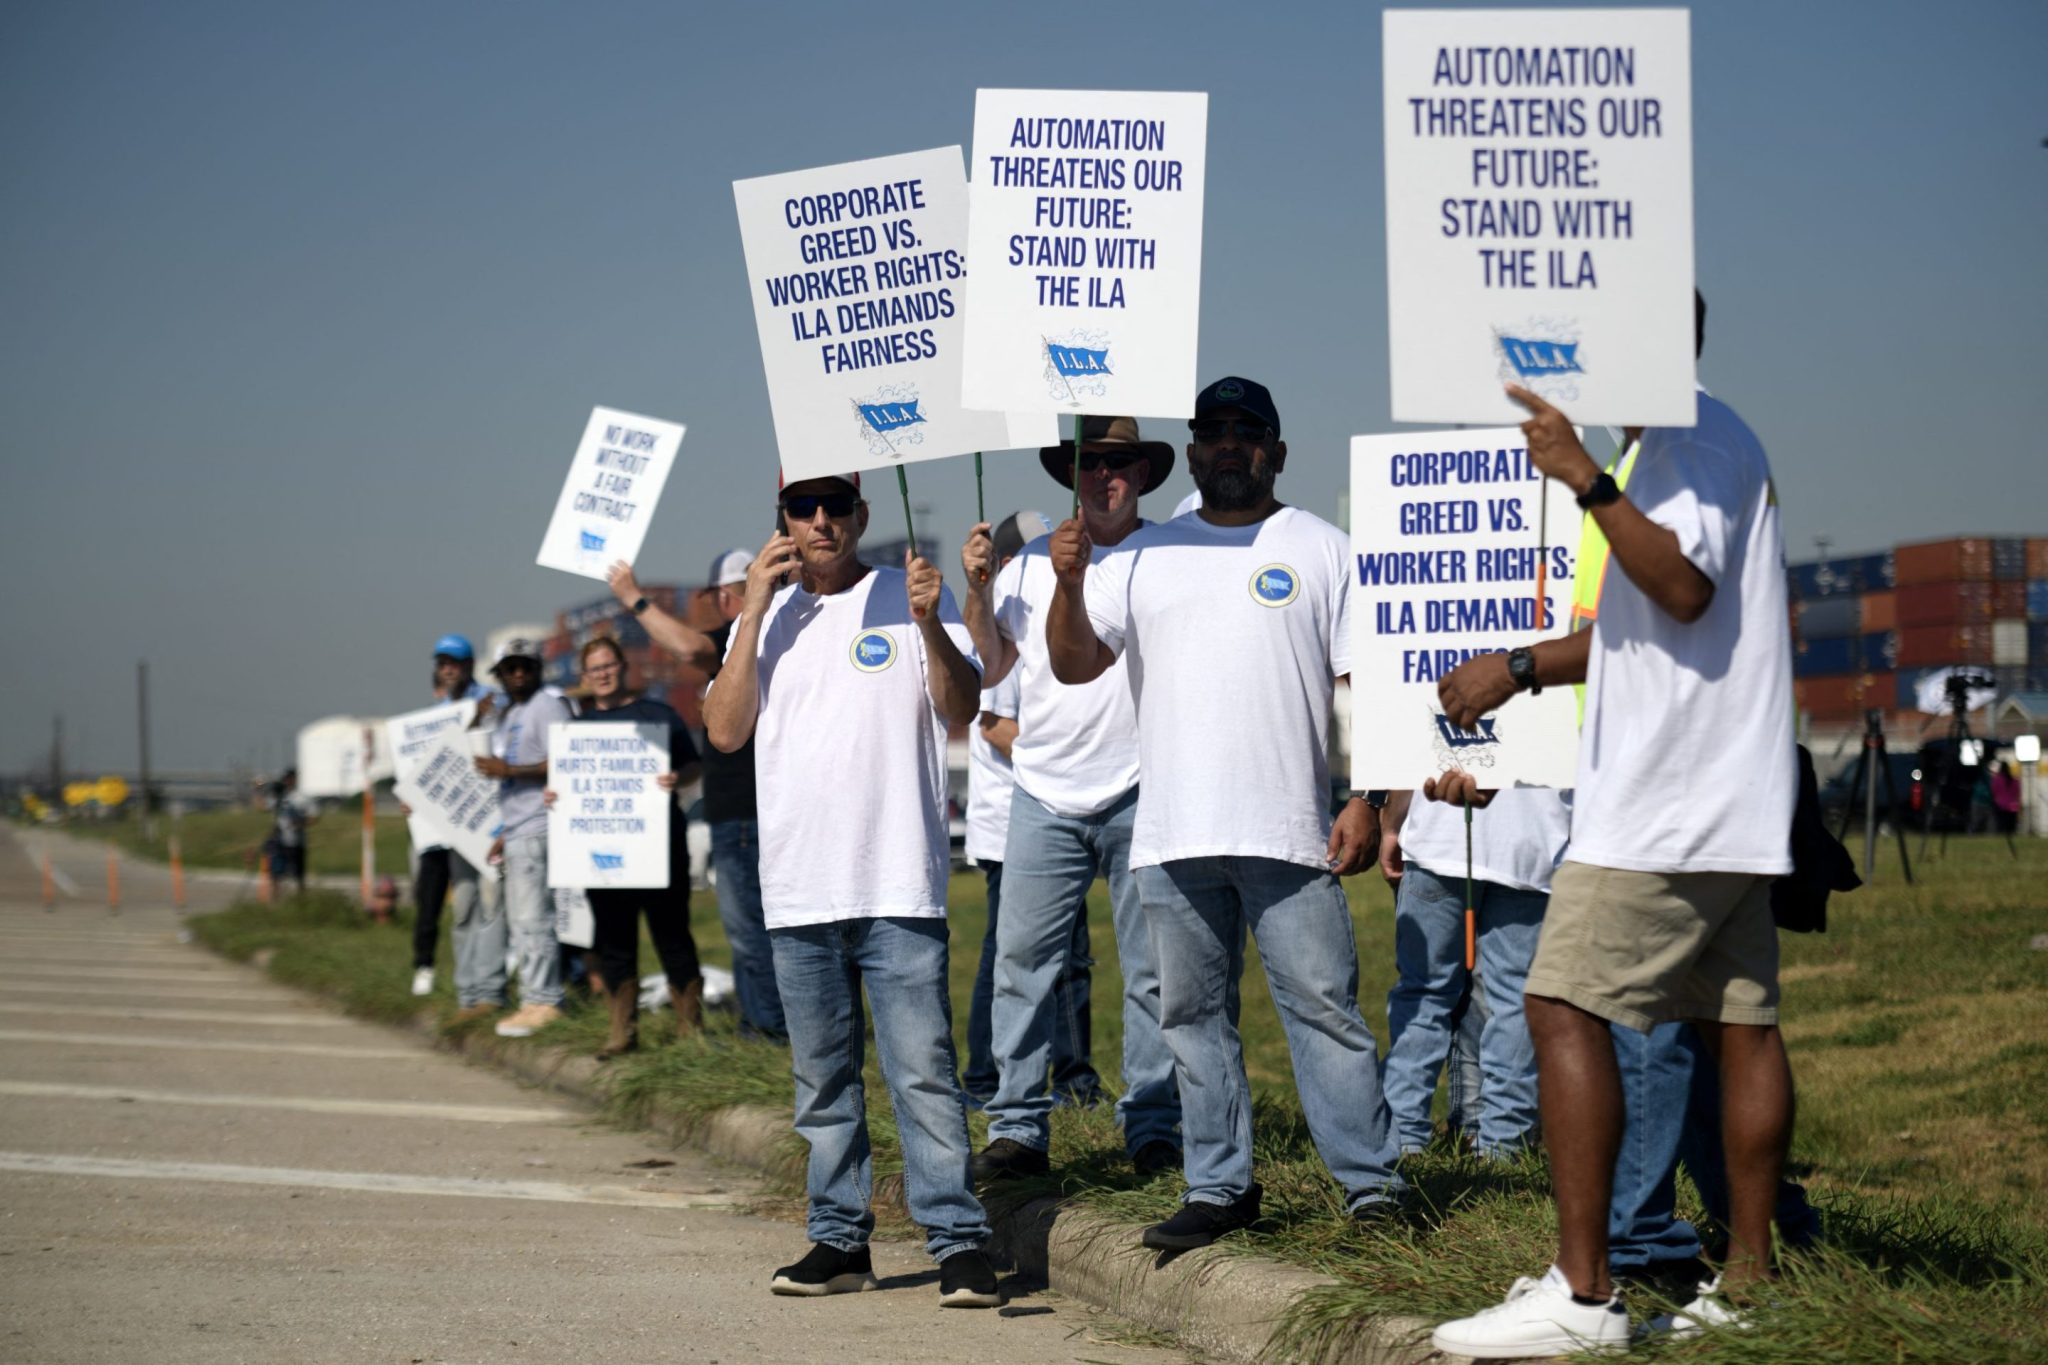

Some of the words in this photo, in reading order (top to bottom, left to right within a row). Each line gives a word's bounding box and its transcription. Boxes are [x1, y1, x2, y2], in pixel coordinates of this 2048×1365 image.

[1433, 47, 1635, 87] AUTOMATION
[1009, 117, 1165, 151] AUTOMATION
[1408, 98, 1586, 138] THREATENS
[1599, 98, 1662, 138] OUR
[990, 156, 1126, 191] THREATENS
[1133, 159, 1183, 192] OUR
[1472, 148, 1599, 188] FUTURE:
[784, 179, 926, 229] CORPORATE
[1035, 196, 1132, 230] FUTURE:
[1441, 198, 1541, 238] STAND
[1553, 199, 1632, 239] WITH
[799, 225, 877, 264] GREED
[884, 219, 922, 251] VS.
[1008, 234, 1086, 268] STAND
[1095, 238, 1156, 270] WITH
[766, 264, 869, 307] WORKER
[875, 248, 968, 289] RIGHTS:
[1478, 248, 1536, 289] THE
[1547, 249, 1597, 289] ILA
[1035, 274, 1079, 307] THE
[1088, 277, 1126, 309] ILA
[791, 305, 832, 341] ILA
[838, 288, 955, 334] DEMANDS
[821, 328, 937, 374] FAIRNESS
[573, 491, 638, 524] CONTRACT
[1400, 499, 1478, 536] GREED
[1488, 498, 1529, 533] VS.
[1357, 549, 1467, 587] WORKER
[1476, 545, 1575, 583] RIGHTS:
[1376, 601, 1416, 635] ILA
[569, 738, 648, 753] AUTOMATION
[556, 757, 597, 774] HURTS
[572, 777, 591, 794] ILA
[595, 777, 645, 794] STANDS
[582, 798, 605, 813] FOR
[611, 798, 634, 813] JOB
[570, 818, 646, 834] PROTECTION
